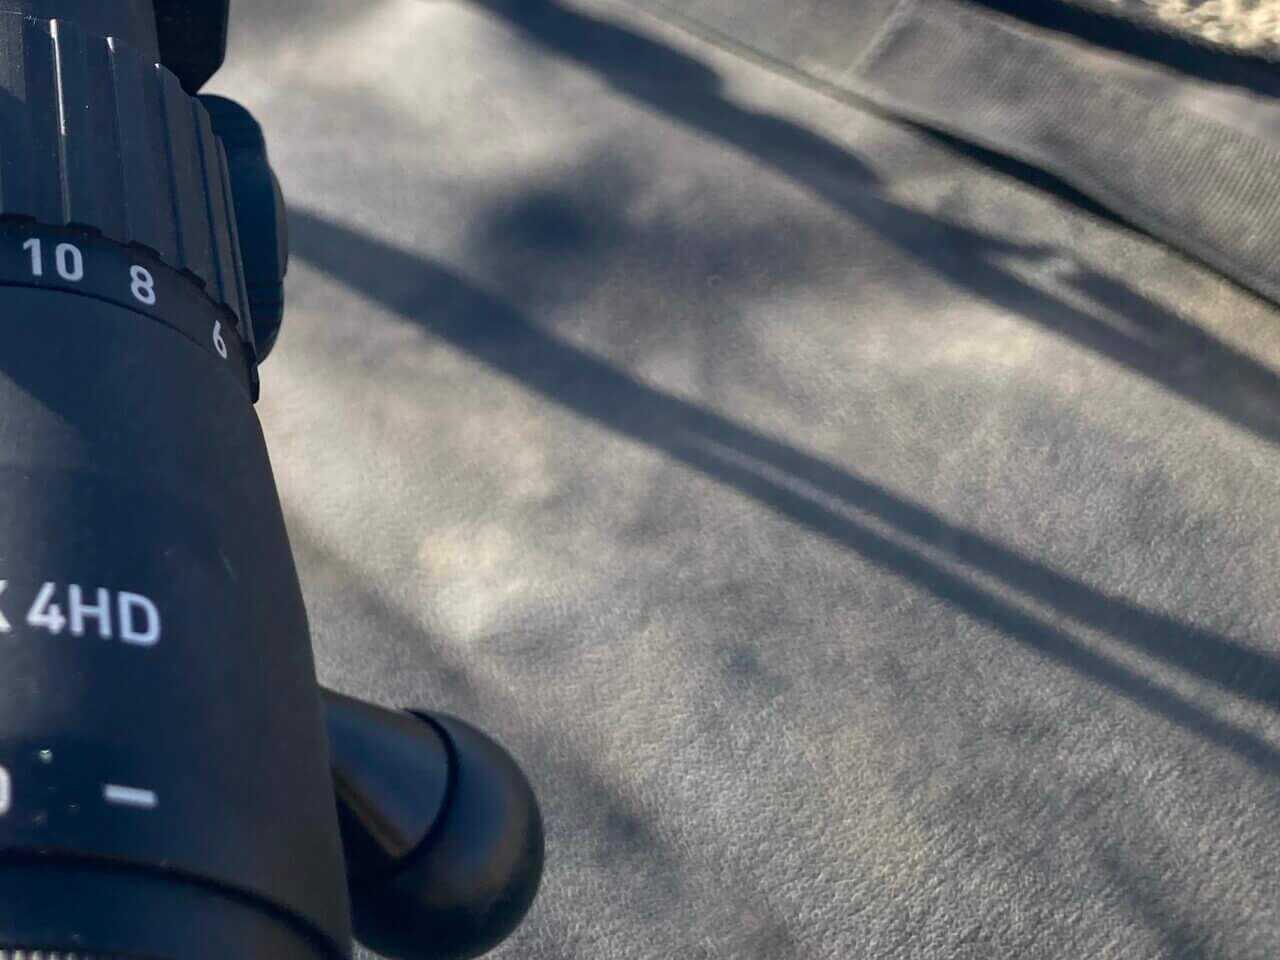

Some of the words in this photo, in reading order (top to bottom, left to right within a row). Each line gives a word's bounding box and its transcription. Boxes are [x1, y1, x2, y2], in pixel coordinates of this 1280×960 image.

[22, 237, 84, 282] 10
[128, 264, 157, 306] 8
[212, 319, 228, 360] 6
[26, 581, 162, 648] 4HD
